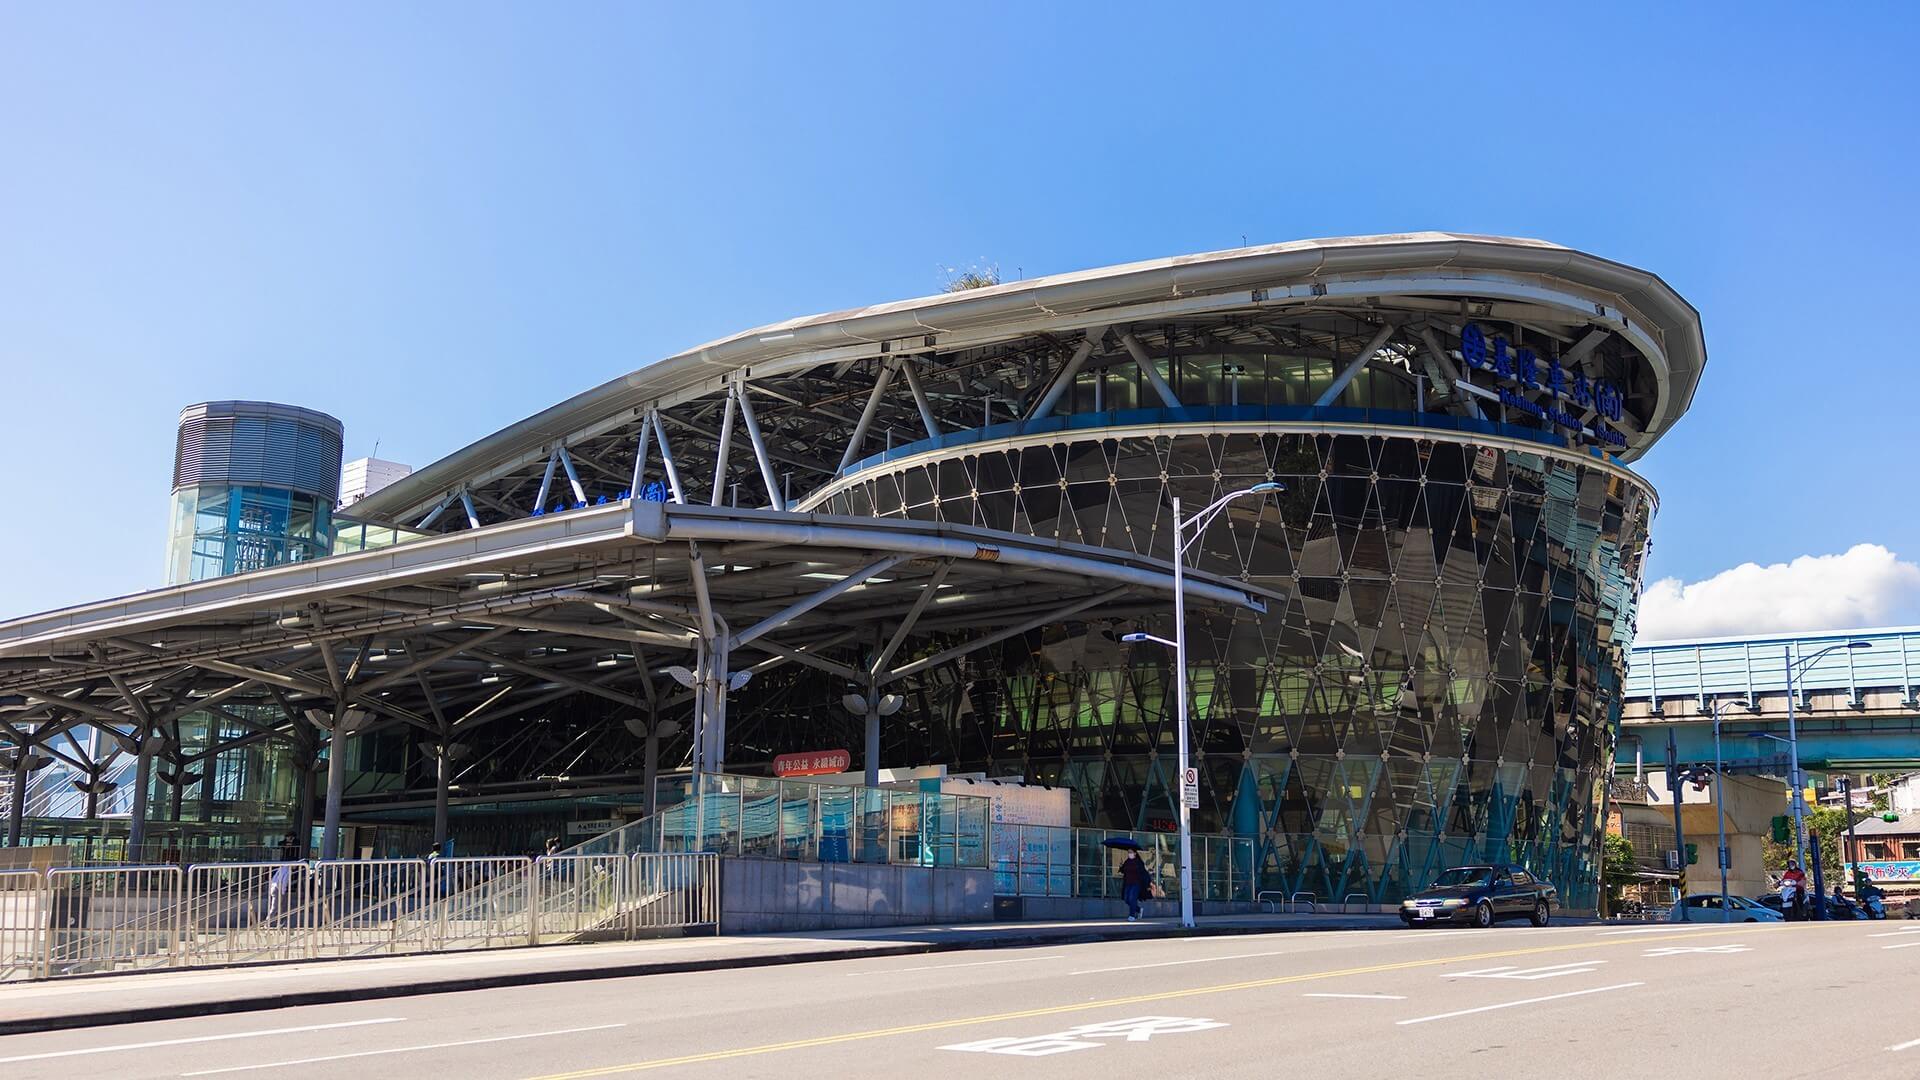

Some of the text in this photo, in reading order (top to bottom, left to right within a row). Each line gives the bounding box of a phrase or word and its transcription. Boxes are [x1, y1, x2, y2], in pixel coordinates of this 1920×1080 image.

[1501, 389, 1627, 448] Keelung Station (South)
[778, 759, 809, 772] 青年公益
